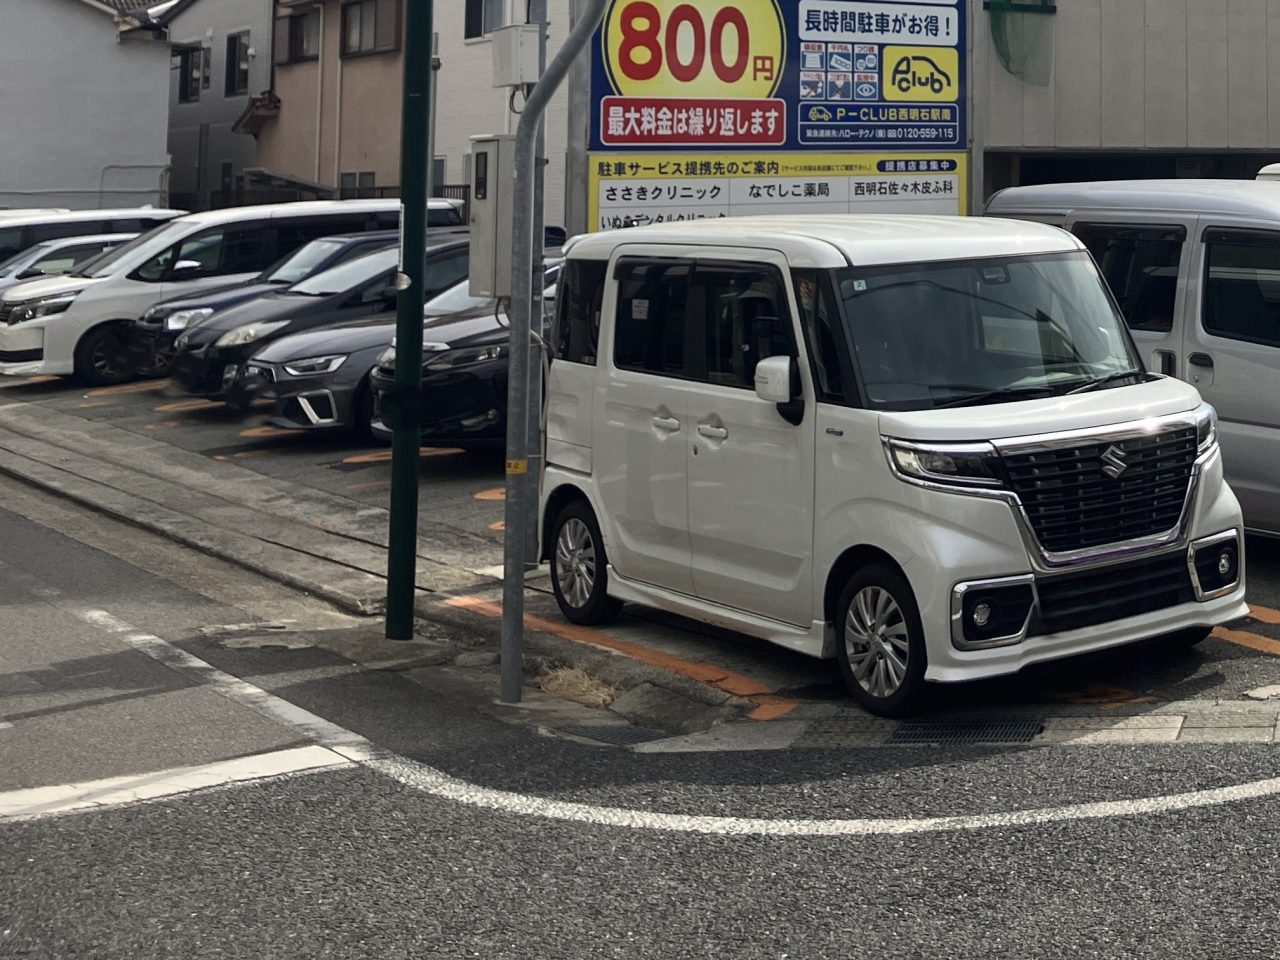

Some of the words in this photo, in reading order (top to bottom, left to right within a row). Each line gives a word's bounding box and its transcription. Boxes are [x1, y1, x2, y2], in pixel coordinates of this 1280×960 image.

[804, 9, 951, 38] 長時間駐車がお得！
[618, 0, 775, 84] 800円
[608, 106, 779, 136] 最大料金は繰り返します
[898, 128, 954, 138] 0120-559-115
[598, 161, 779, 176] 駐車サービス提携先のご案内
[606, 185, 721, 201] ささきクリニック
[749, 183, 830, 198] なでしこ薬局
[854, 180, 953, 196] 西明石佐々木皮ふ科
